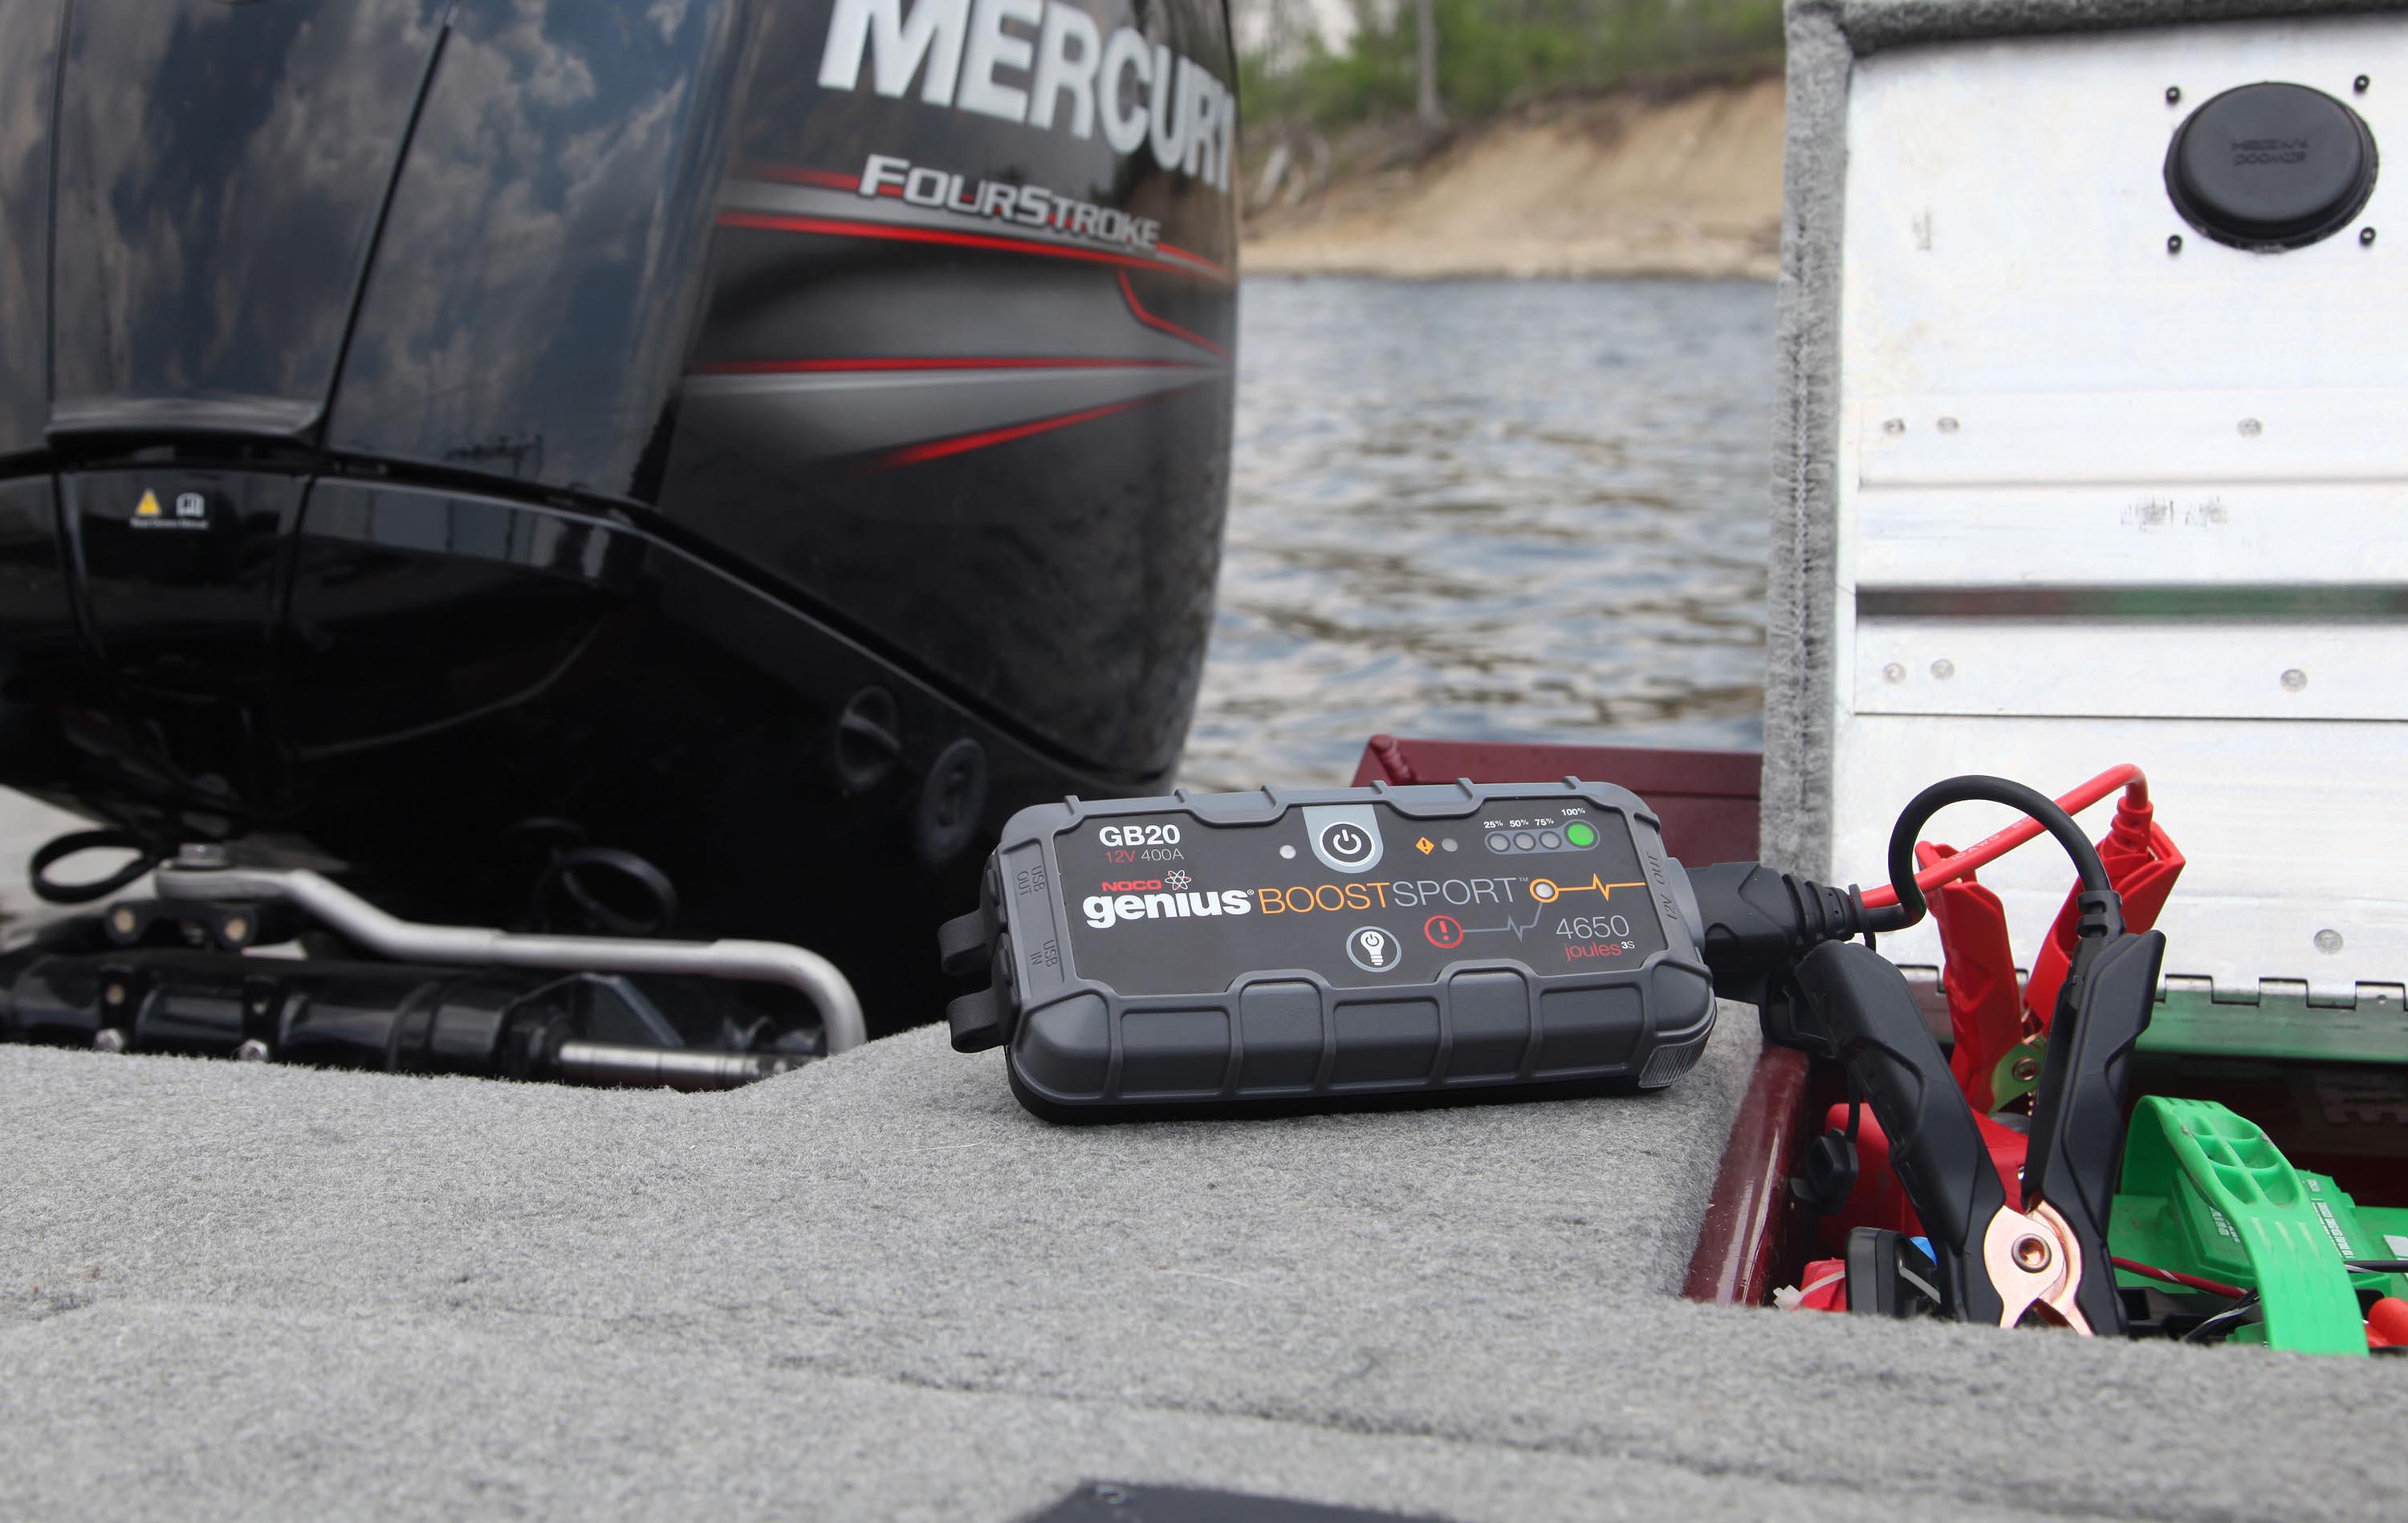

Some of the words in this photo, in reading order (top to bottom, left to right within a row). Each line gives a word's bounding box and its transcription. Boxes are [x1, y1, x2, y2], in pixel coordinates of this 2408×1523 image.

[1560, 807, 1586, 816] 100%
[1483, 820, 1503, 829] 25%
[1509, 819, 1529, 827] 50%
[1534, 818, 1555, 826] 75%
[1099, 824, 1181, 847] GB20
[1105, 850, 1136, 863] 12V
[1141, 848, 1185, 861] 400A
[1031, 865, 1046, 892] USB
[1645, 851, 1666, 885] OUT
[1017, 871, 1032, 896] OUT
[1101, 879, 1163, 892] NOCO
[1659, 892, 1678, 920] 12V
[1556, 915, 1629, 939] 4650
[1030, 951, 1043, 965] IN
[1043, 939, 1059, 968] USB
